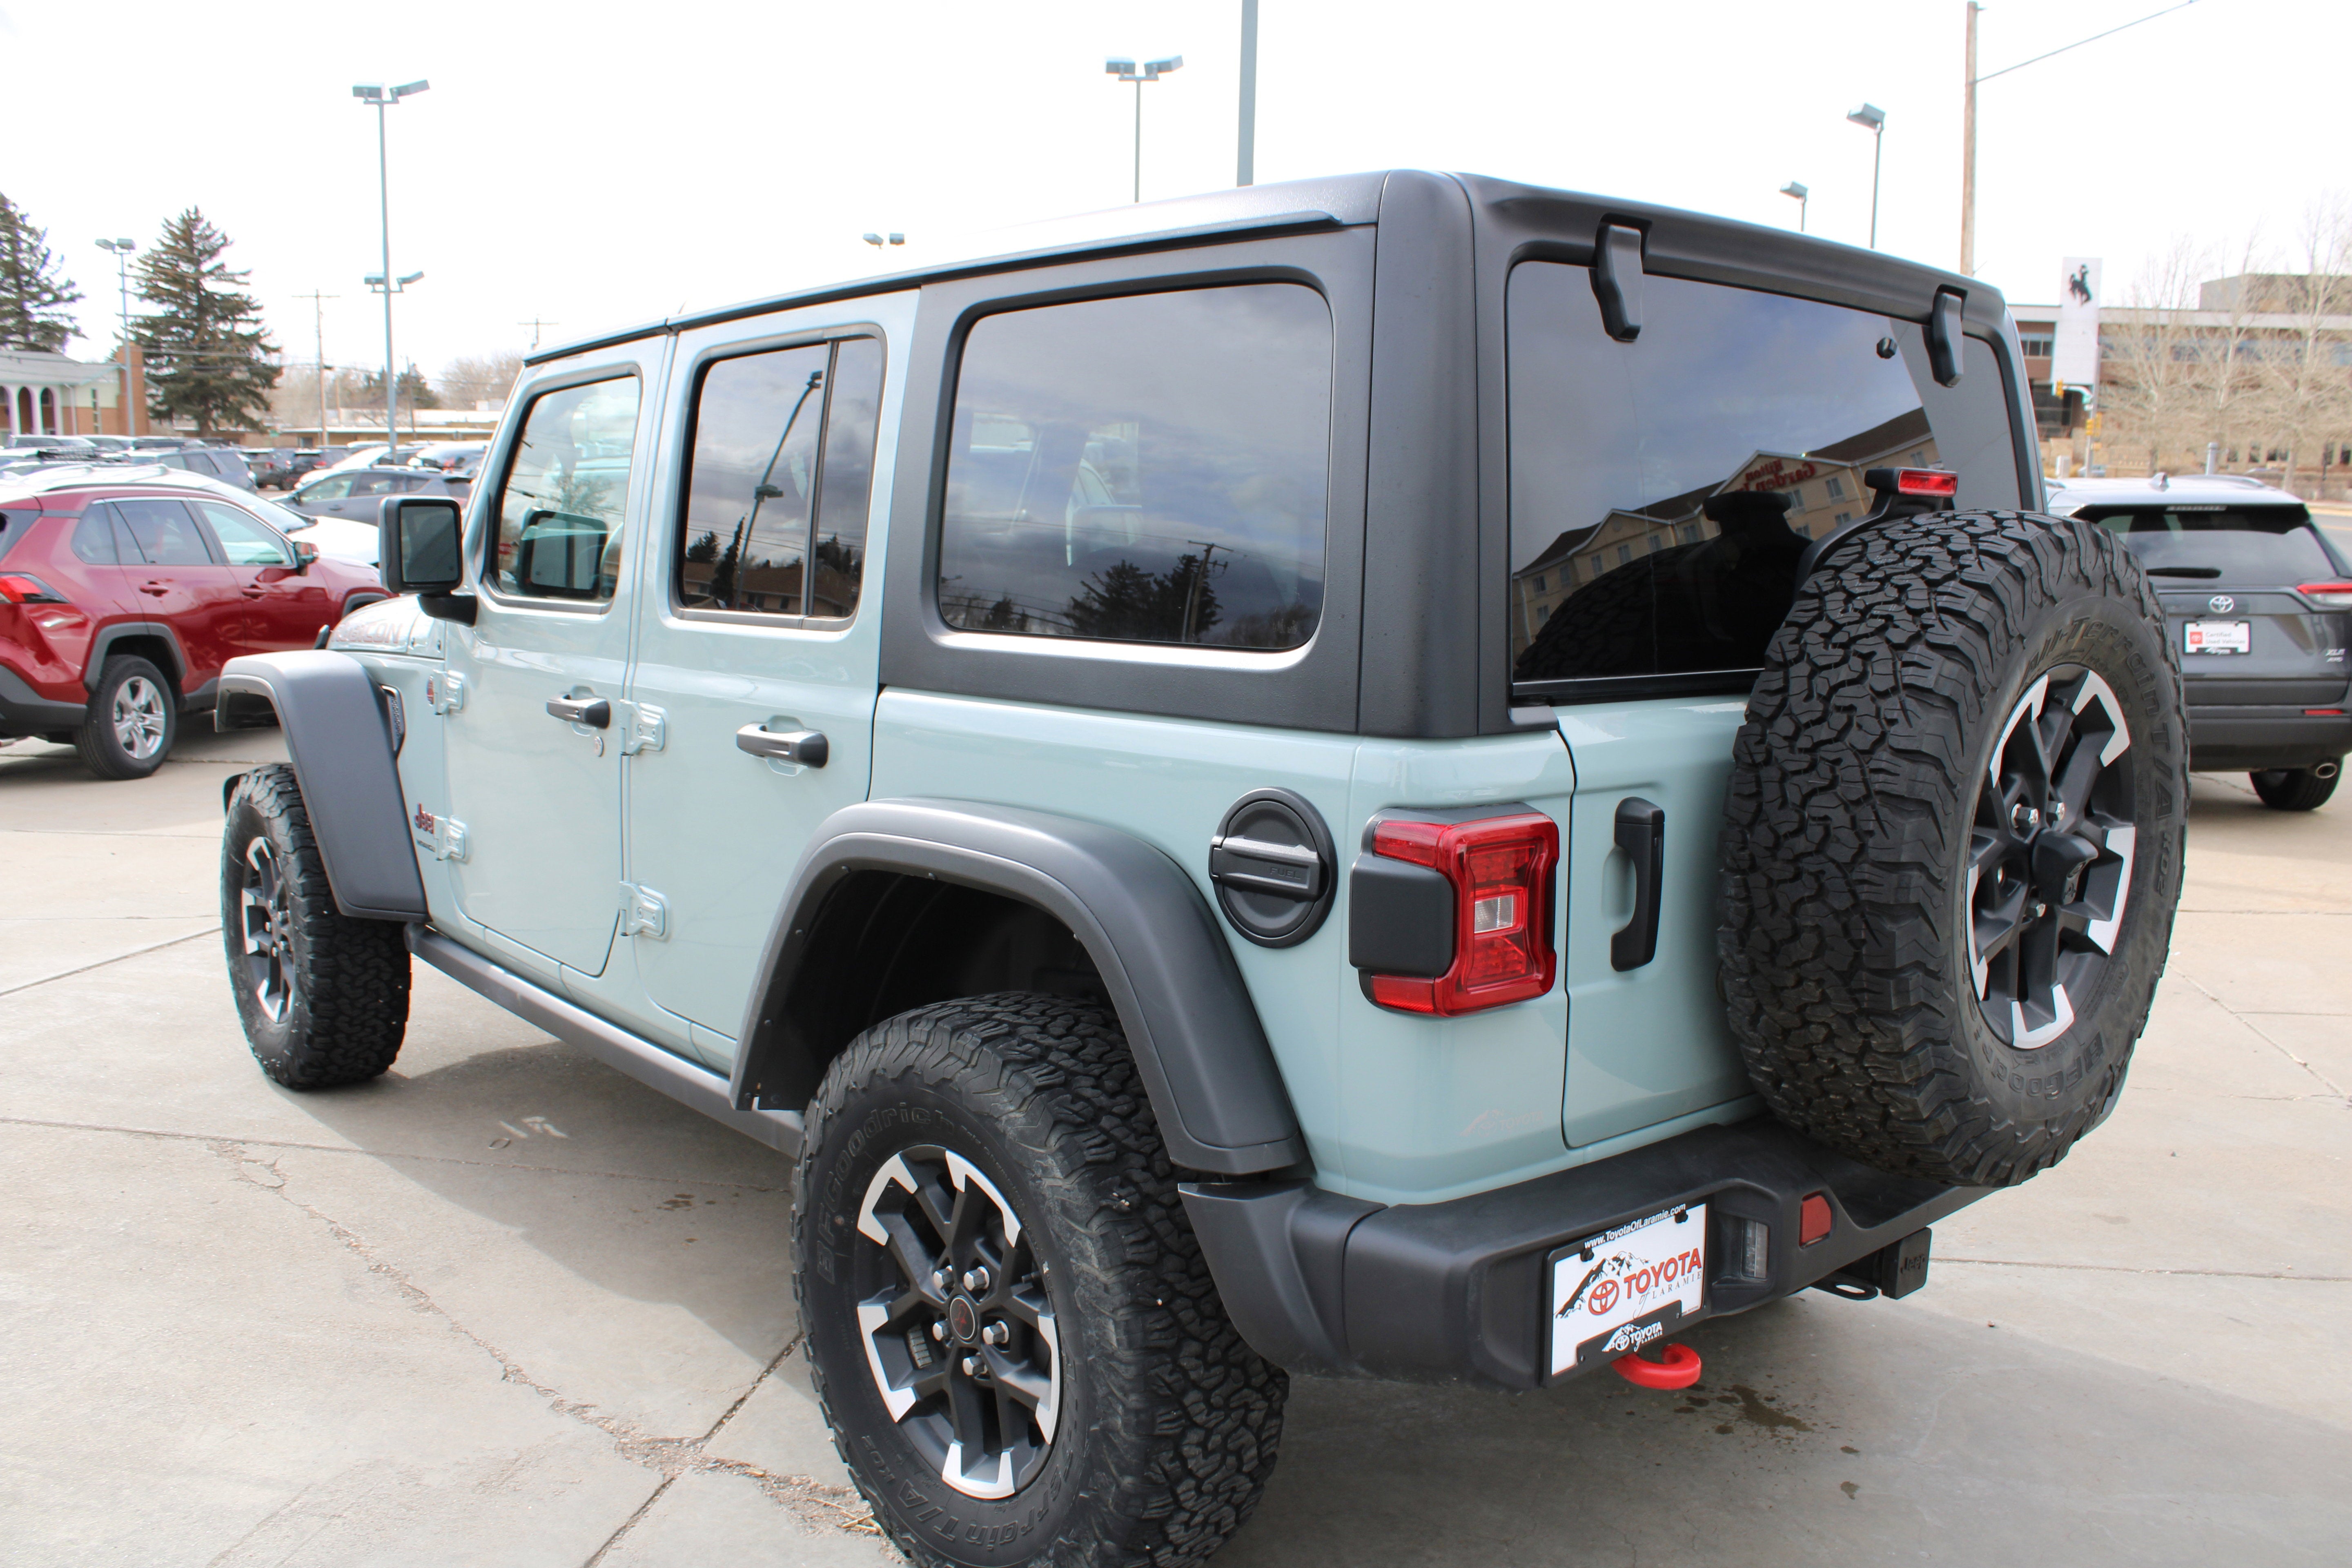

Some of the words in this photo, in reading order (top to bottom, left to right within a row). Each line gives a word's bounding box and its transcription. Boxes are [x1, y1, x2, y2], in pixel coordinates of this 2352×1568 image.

[414, 802, 434, 834] Jee
[1269, 866, 1302, 880] FUEL
[817, 1102, 955, 1285] BFGoodrich
[1584, 1203, 1686, 1249] www.ToyotaOfLaramie.com
[1624, 1247, 1702, 1299] TOYOTA
[1652, 1270, 1703, 1300] LARAMIE
[1629, 1321, 1663, 1344] TOYOTA
